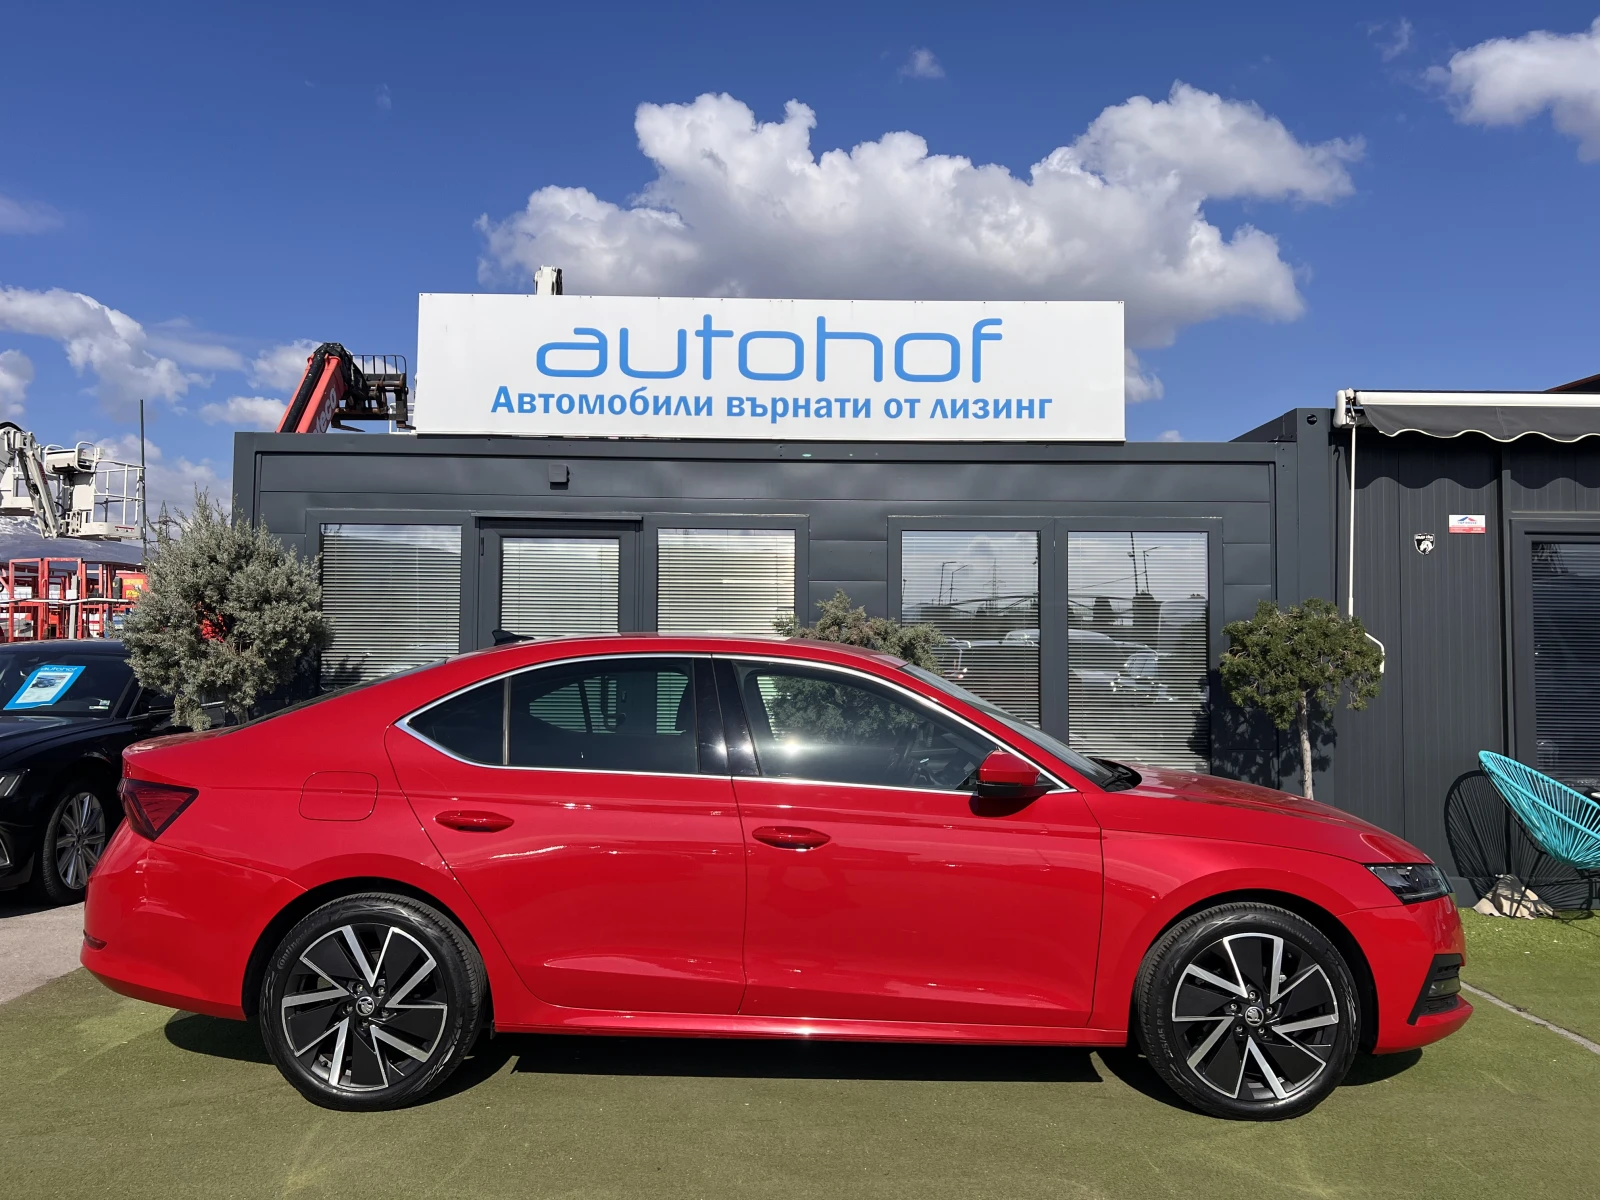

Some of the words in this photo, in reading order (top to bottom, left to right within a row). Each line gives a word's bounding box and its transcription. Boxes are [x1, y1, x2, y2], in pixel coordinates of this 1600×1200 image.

[535, 313, 1003, 383] autohof
[491, 385, 713, 417] Автомобили
[727, 396, 871, 424] върнати
[884, 398, 921, 419] от
[931, 398, 1053, 419] лизинг
